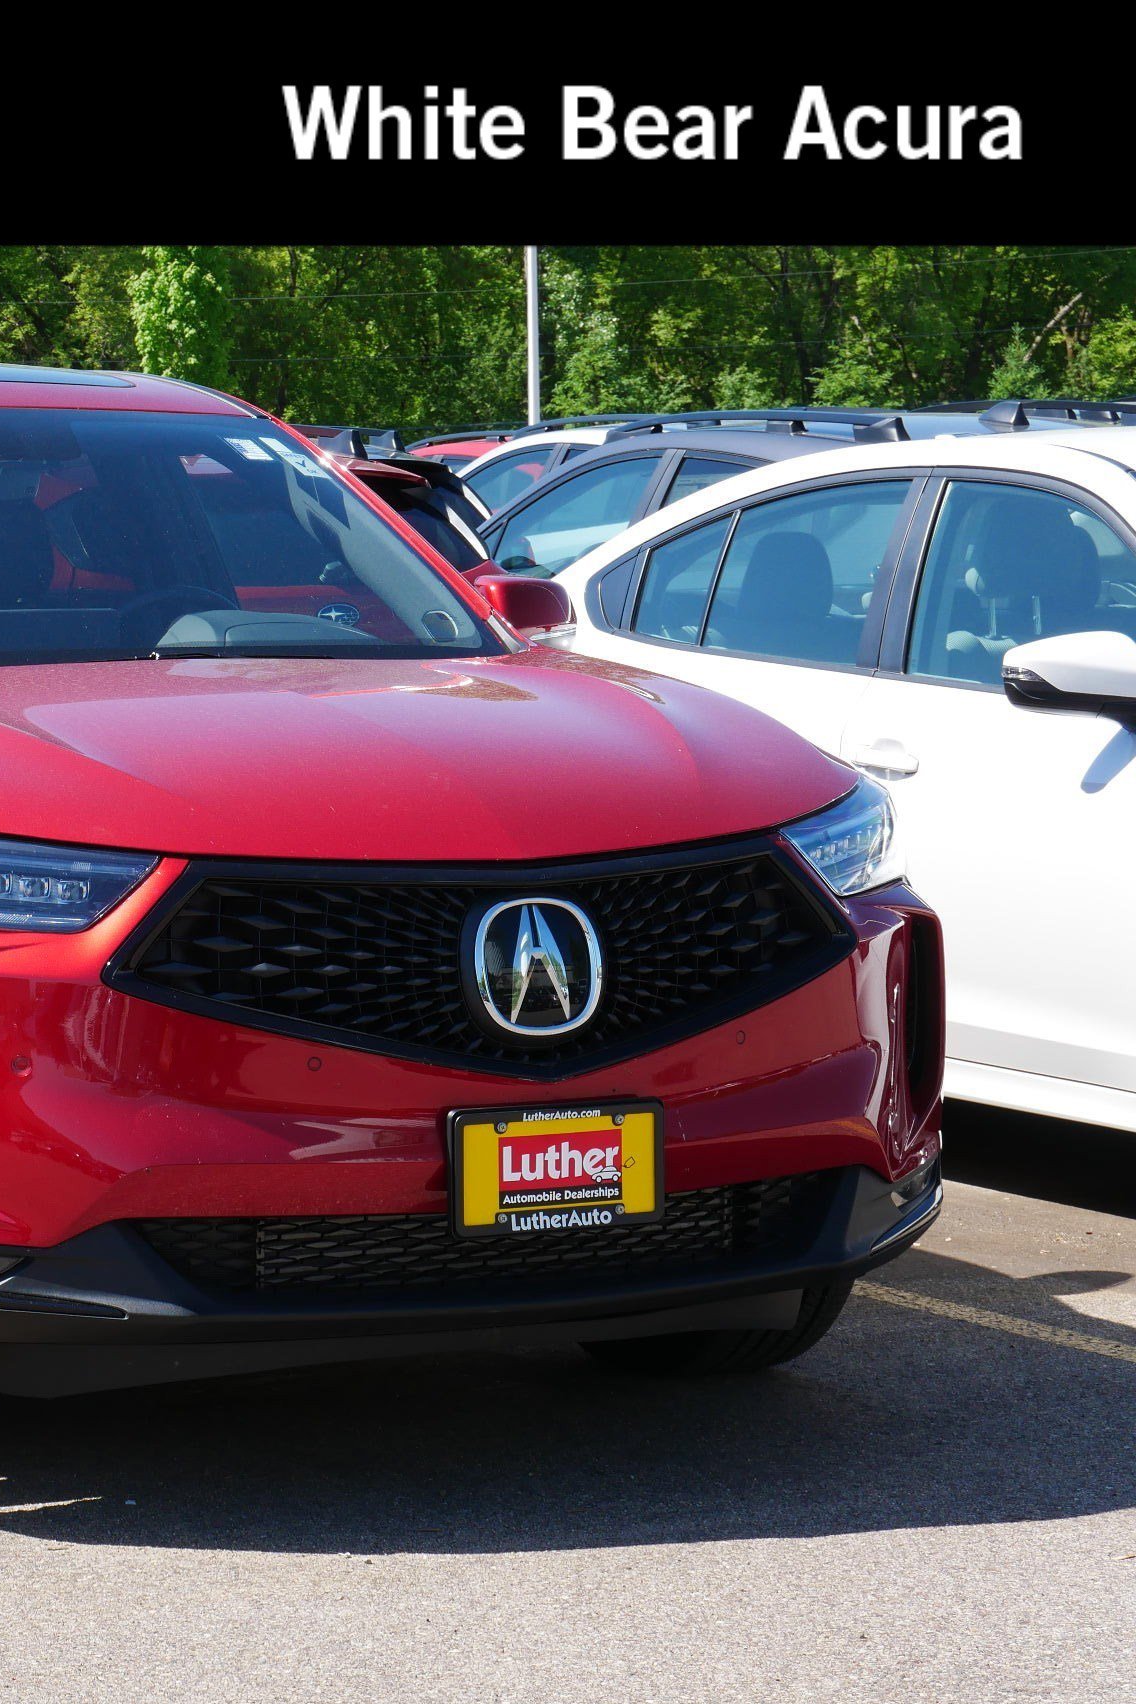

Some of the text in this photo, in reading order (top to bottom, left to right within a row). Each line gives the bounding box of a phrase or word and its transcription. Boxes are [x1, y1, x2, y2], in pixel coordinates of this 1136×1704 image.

[522, 1109, 601, 1122] LutherAuto.com
[502, 1141, 619, 1182] Luther
[503, 1187, 619, 1204] Automobile Dealerships
[511, 1209, 612, 1231] LutherAuto
